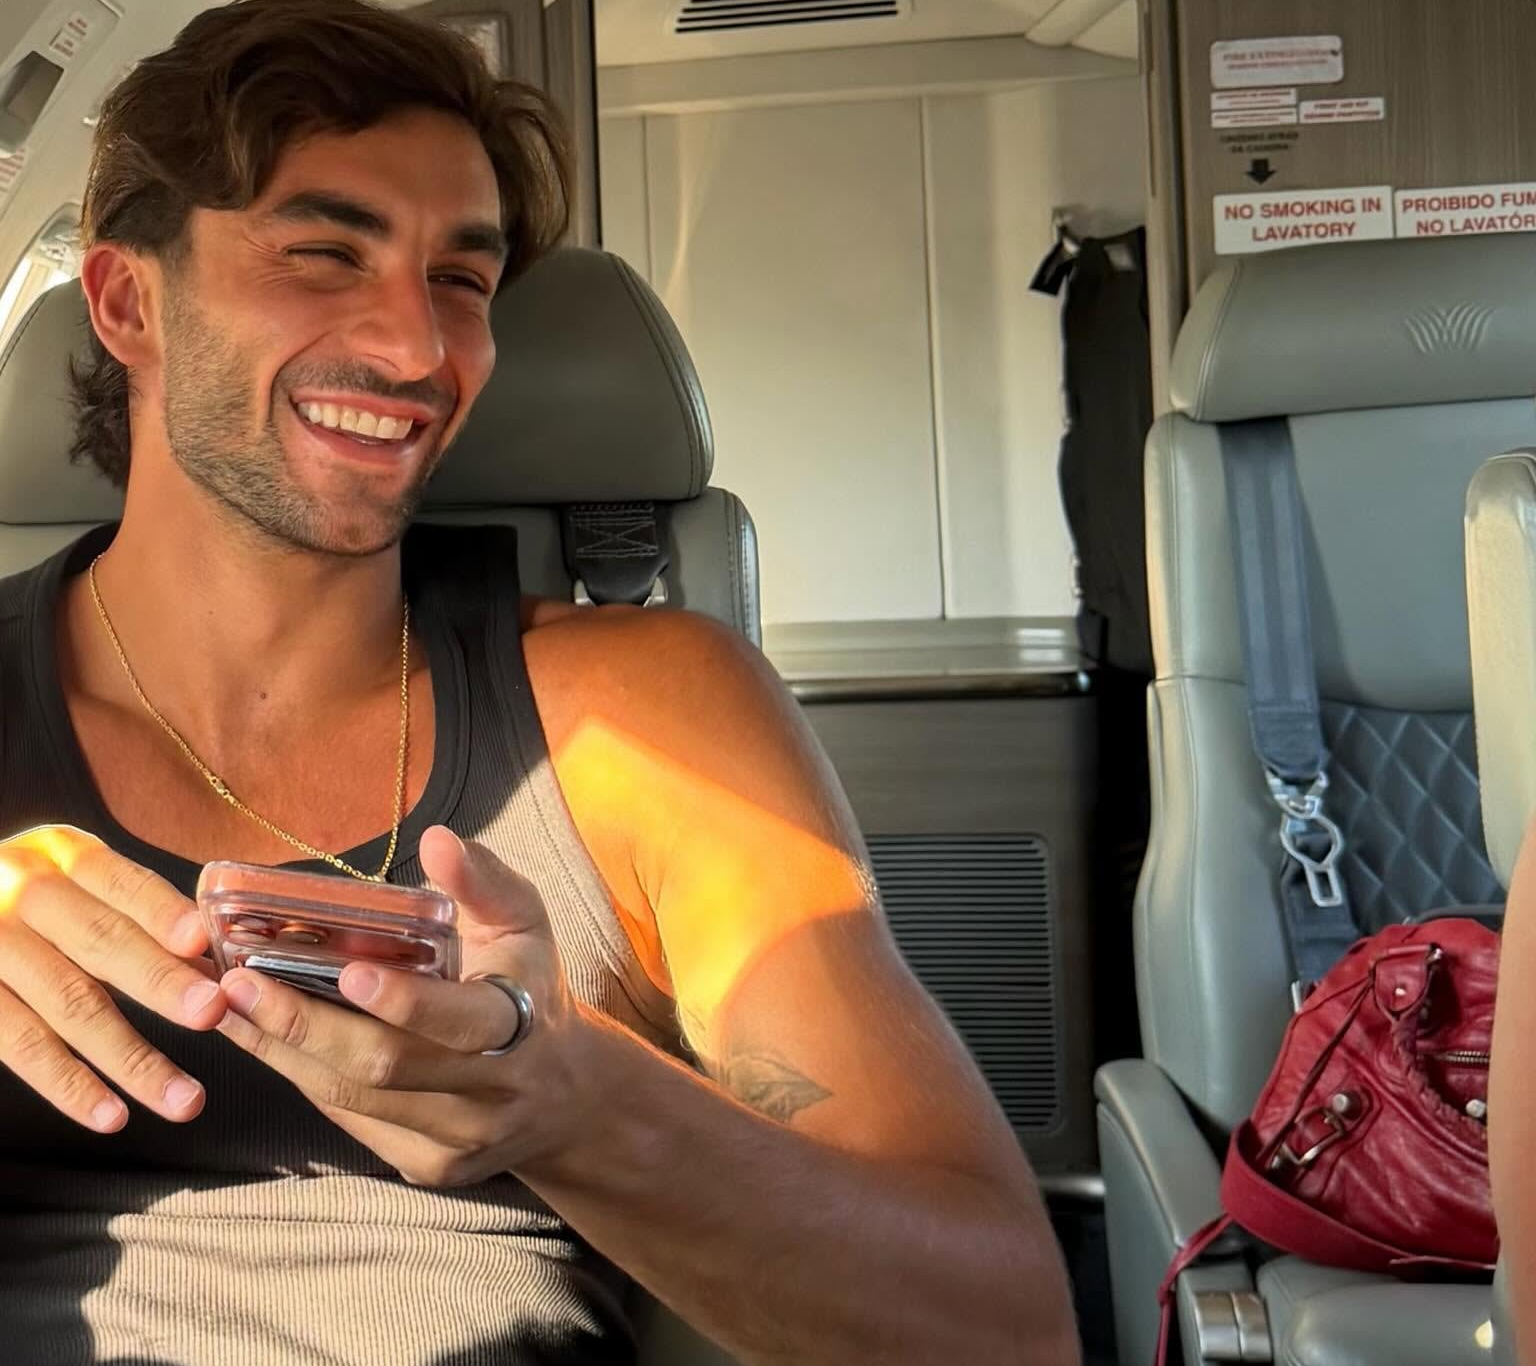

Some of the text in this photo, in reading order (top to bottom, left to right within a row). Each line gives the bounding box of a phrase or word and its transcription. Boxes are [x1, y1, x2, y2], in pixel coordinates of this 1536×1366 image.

[1224, 197, 1381, 220] NO SMOKING IN
[1402, 193, 1495, 213] PROIBIDO
[1252, 221, 1356, 242] LAVATORY
[1416, 220, 1443, 234] NO
